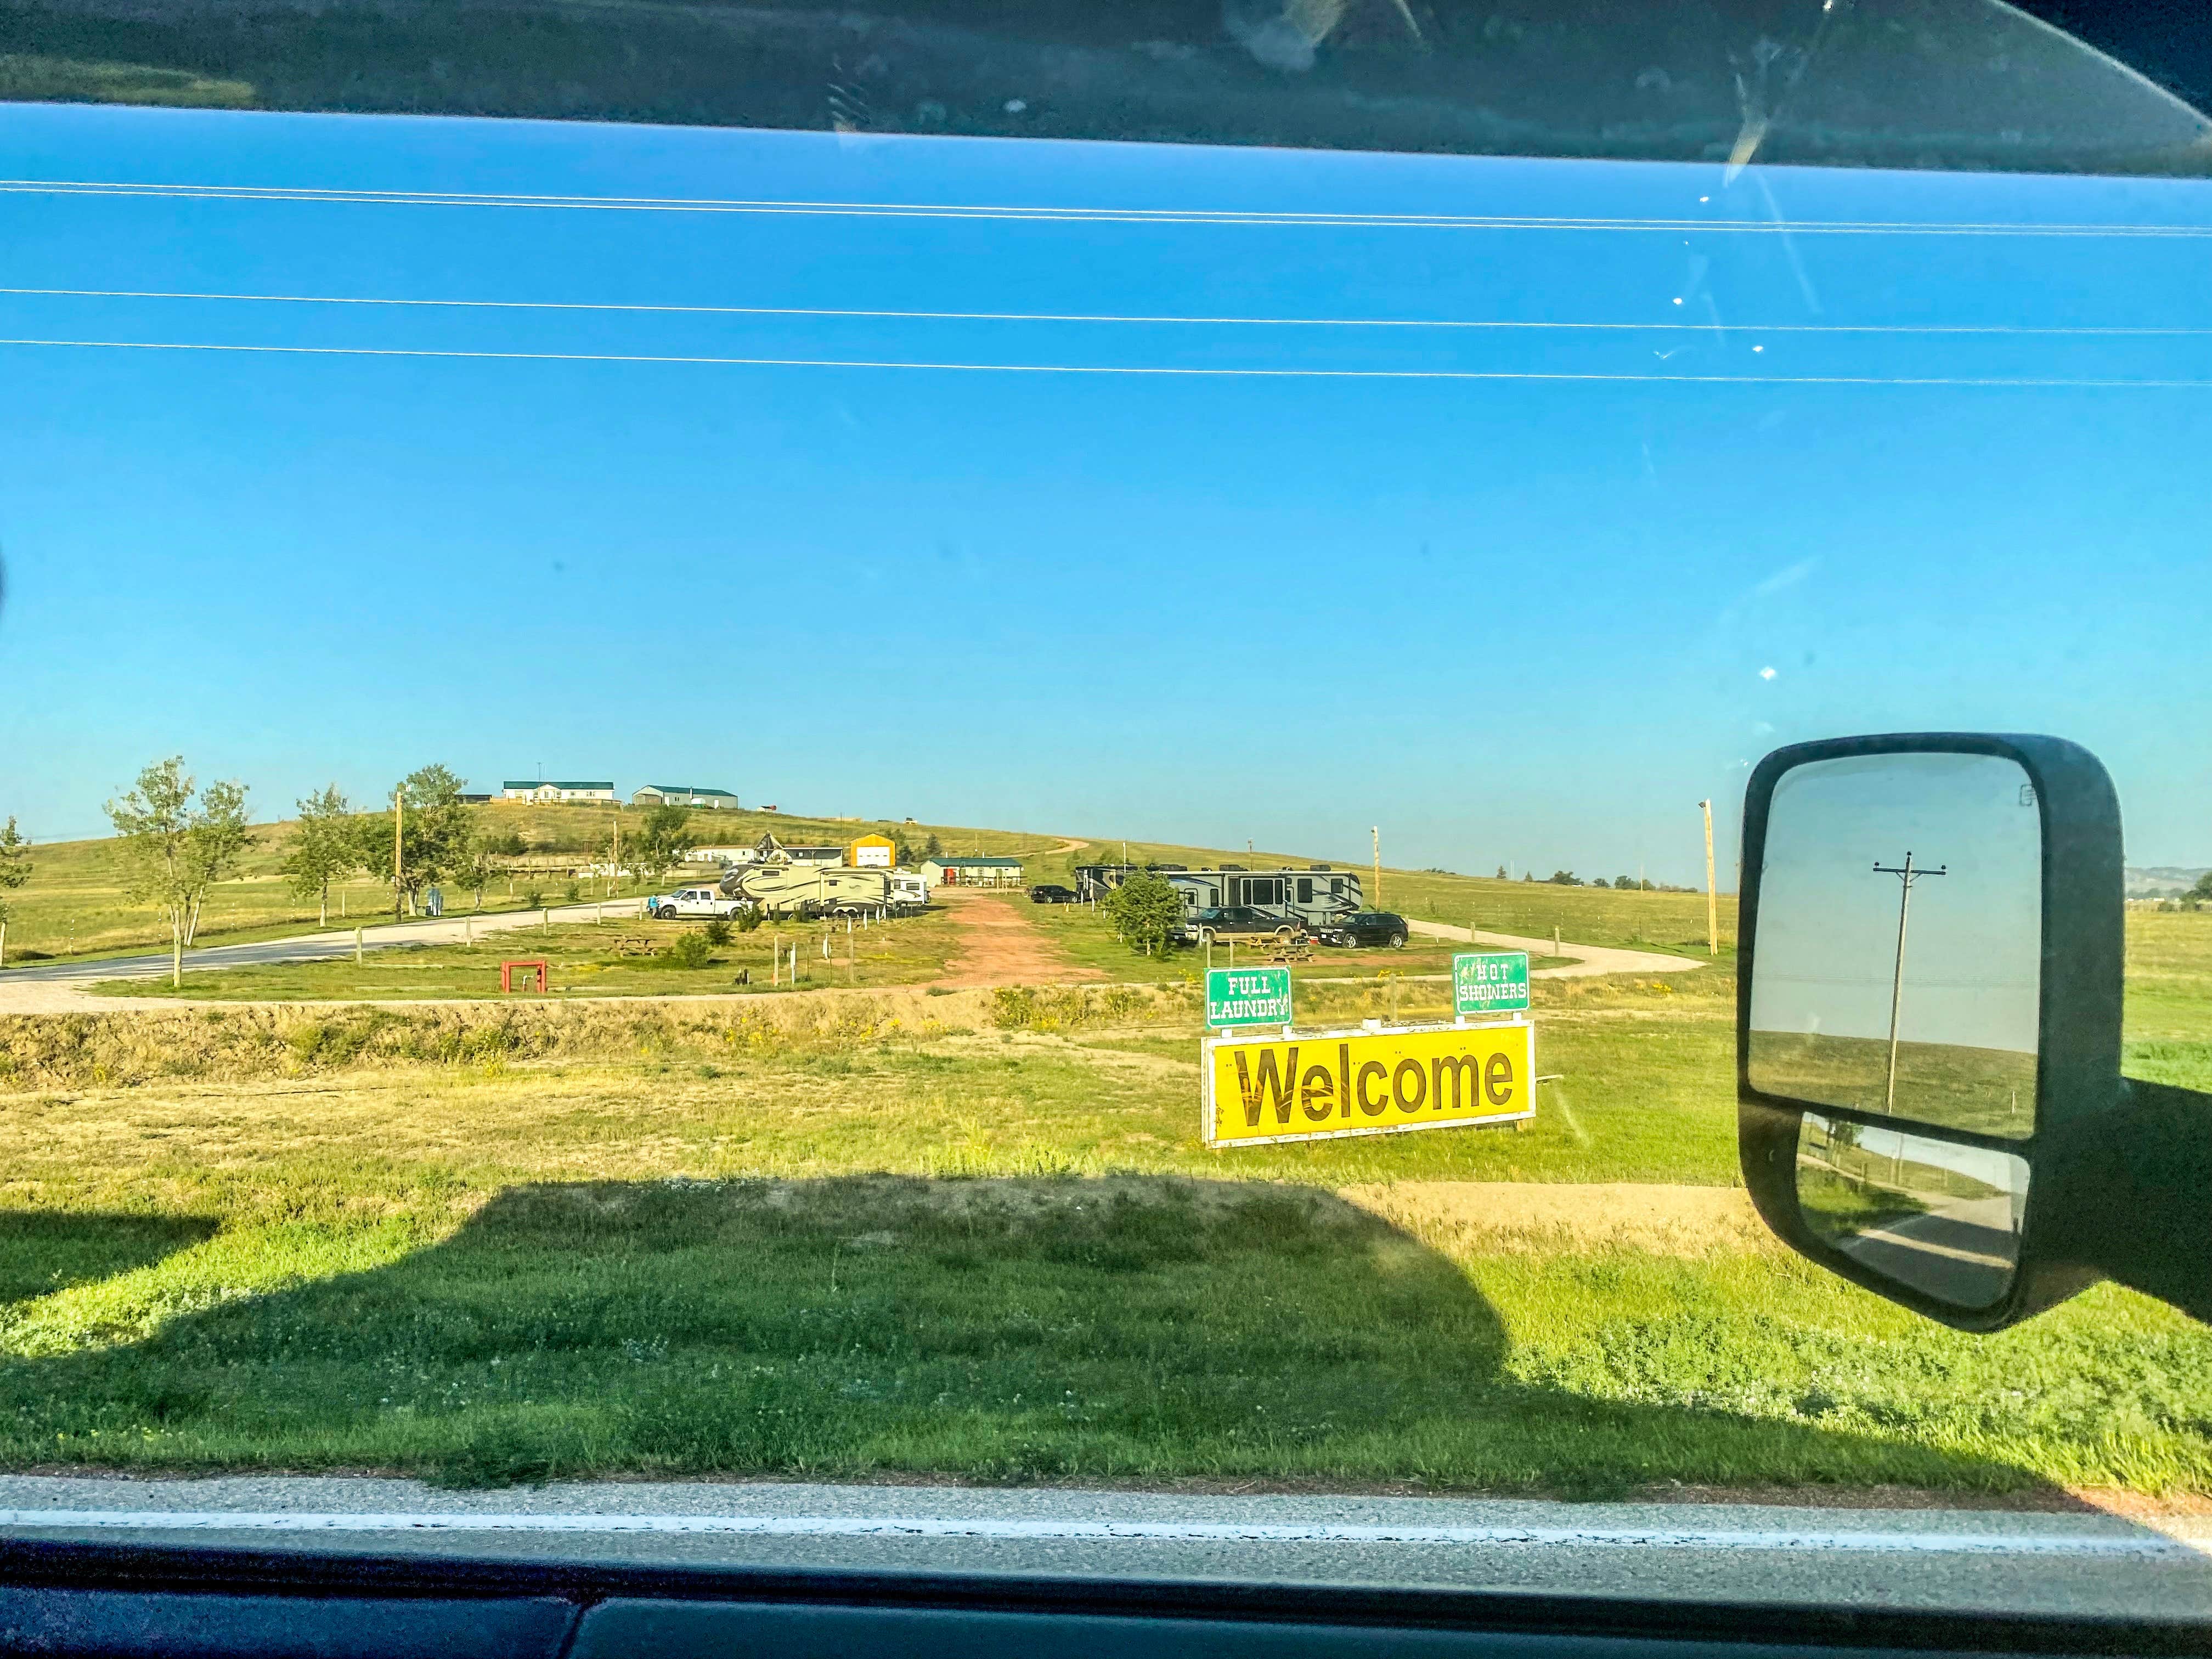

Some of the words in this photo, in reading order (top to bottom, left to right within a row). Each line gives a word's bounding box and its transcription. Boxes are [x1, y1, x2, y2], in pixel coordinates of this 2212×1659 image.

[1476, 963, 1509, 980] HOT
[1228, 976, 1271, 995] FULL
[1459, 982, 1527, 1001] SHOWERS
[1210, 998, 1288, 1020] LAUNDRY
[1234, 1043, 1513, 1126] Welcome
